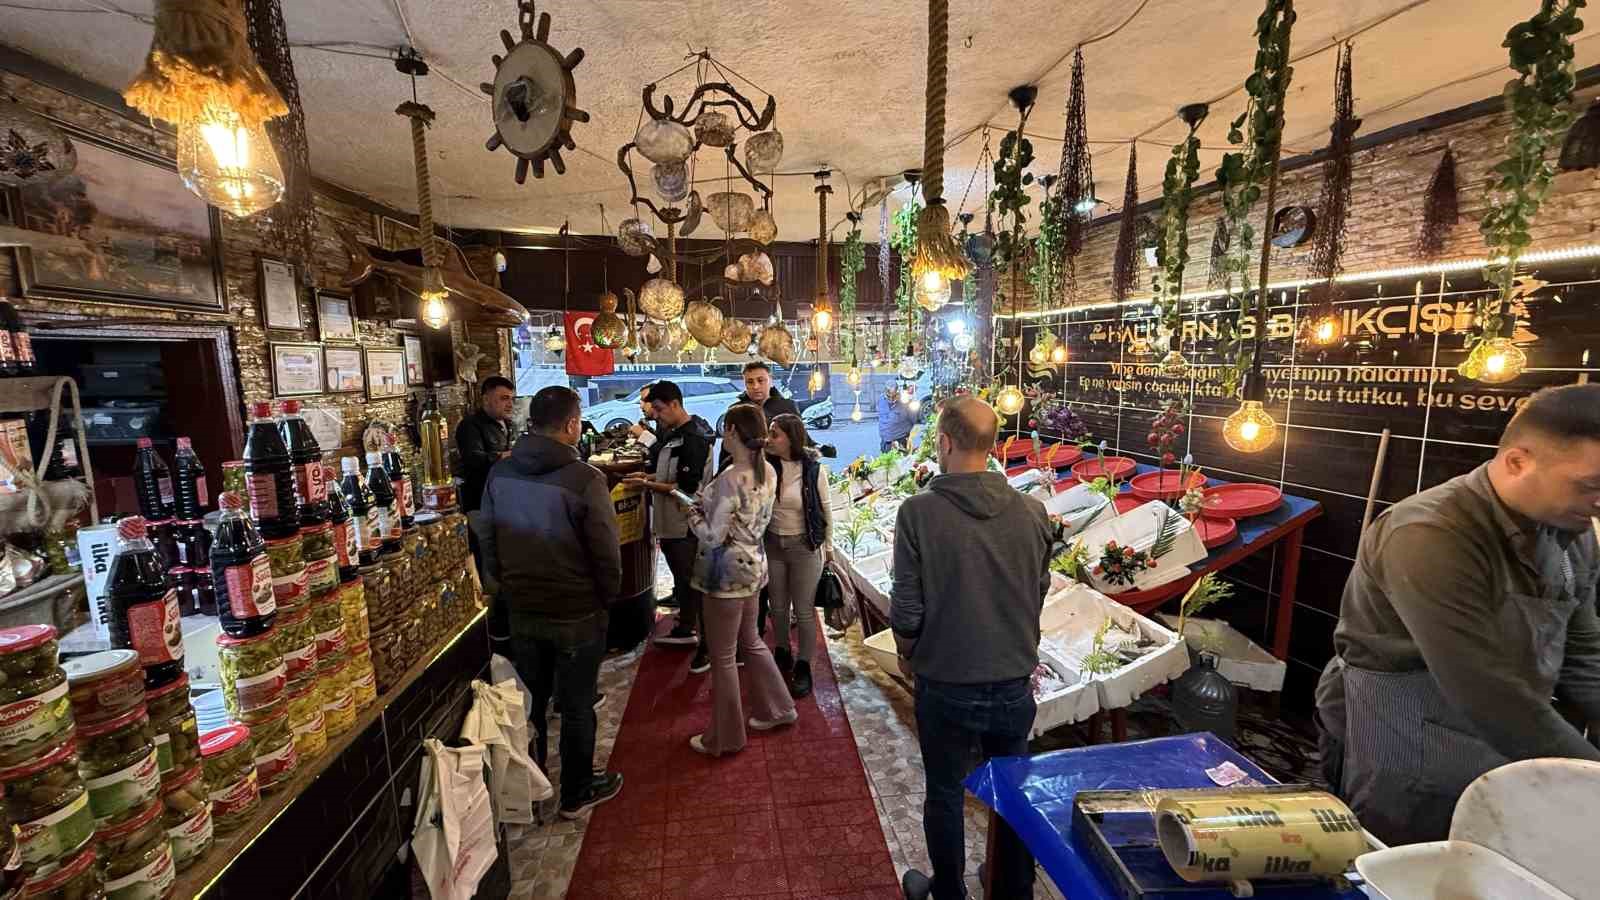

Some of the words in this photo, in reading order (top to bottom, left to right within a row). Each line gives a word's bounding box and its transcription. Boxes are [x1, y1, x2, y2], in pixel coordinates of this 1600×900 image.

[1305, 385, 1331, 401] bu
[1417, 387, 1454, 407] bu
[91, 543, 109, 574] ilka
[1264, 855, 1311, 874] ilka
